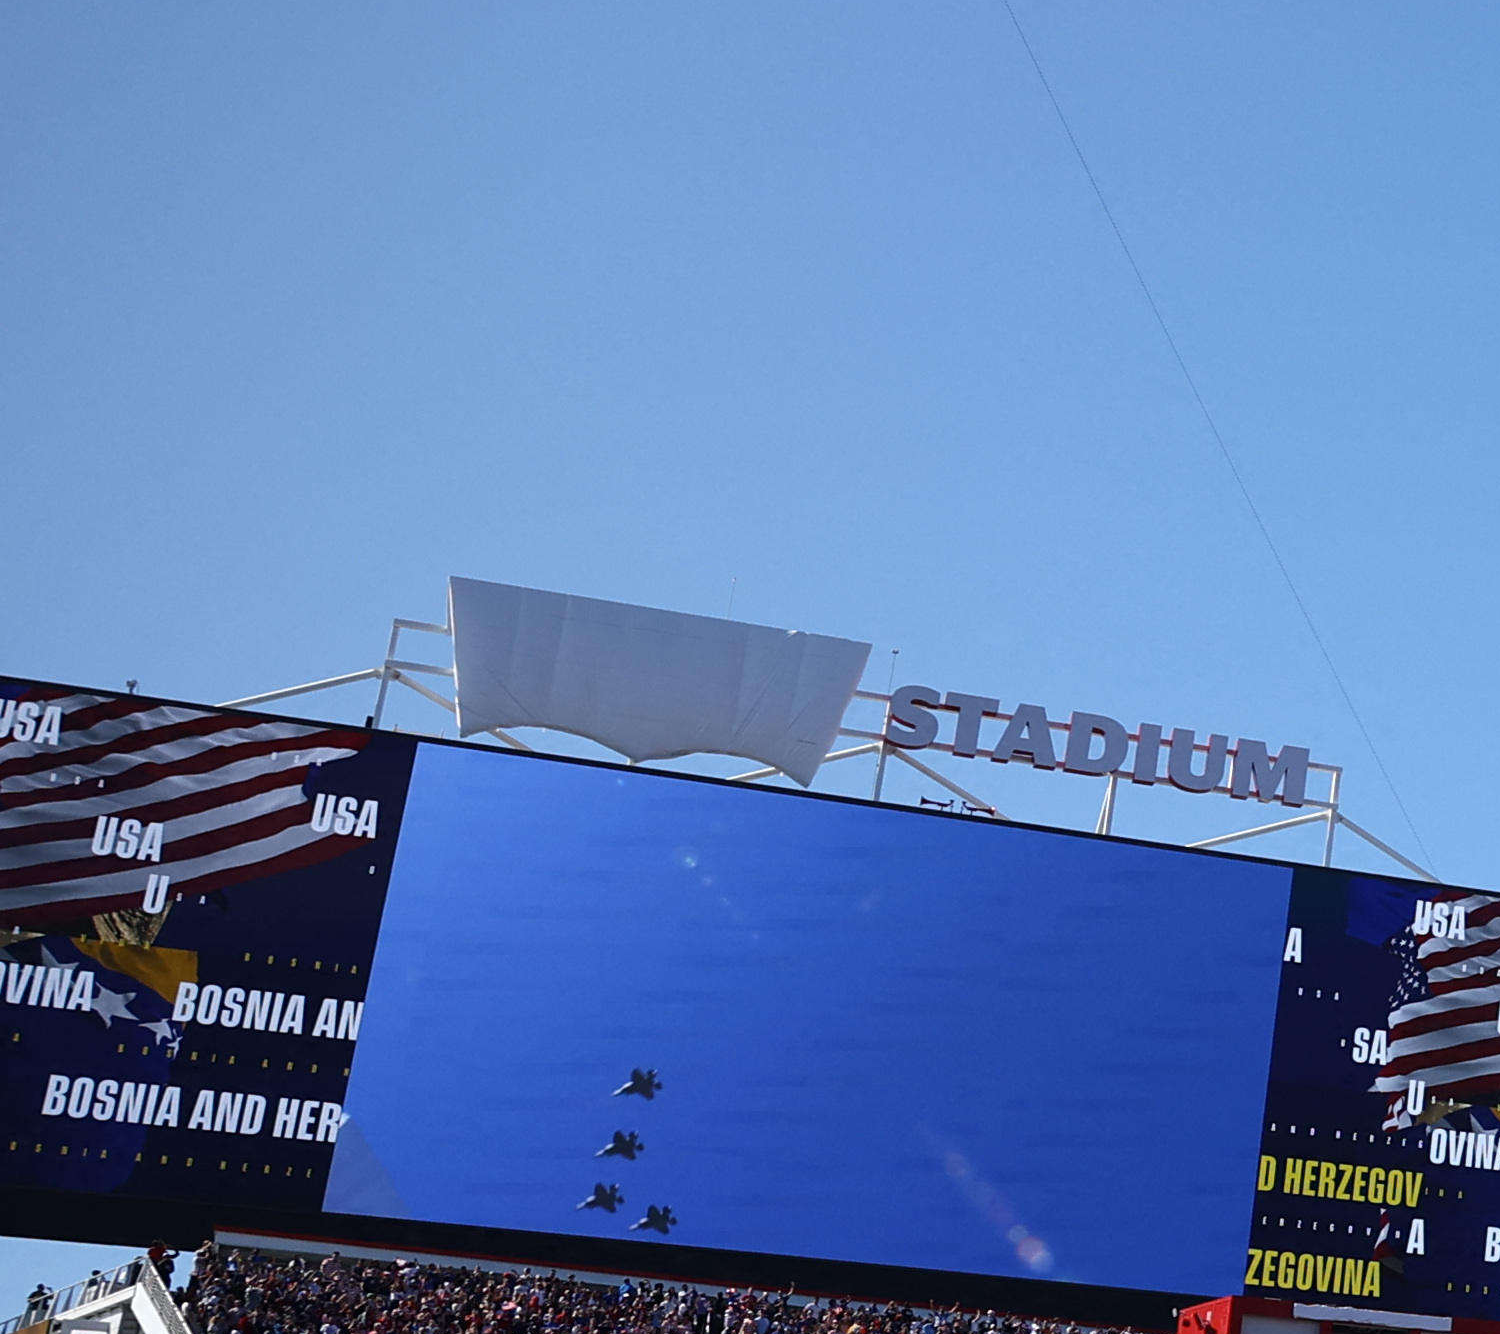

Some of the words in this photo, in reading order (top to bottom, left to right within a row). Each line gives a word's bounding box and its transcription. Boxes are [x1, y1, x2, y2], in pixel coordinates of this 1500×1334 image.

[884, 685, 1309, 807] STADIUM
[91, 816, 164, 862] USA
[310, 793, 379, 838] USA
[1414, 900, 1465, 940] USA
[172, 981, 305, 1034] BOSNIA
[42, 1074, 181, 1128] BOSNIA
[188, 1090, 266, 1135] AND
[272, 1098, 341, 1143] HER
[1283, 1157, 1423, 1207] HERZEGOV
[1245, 1248, 1380, 1297] ZEGOVINA
